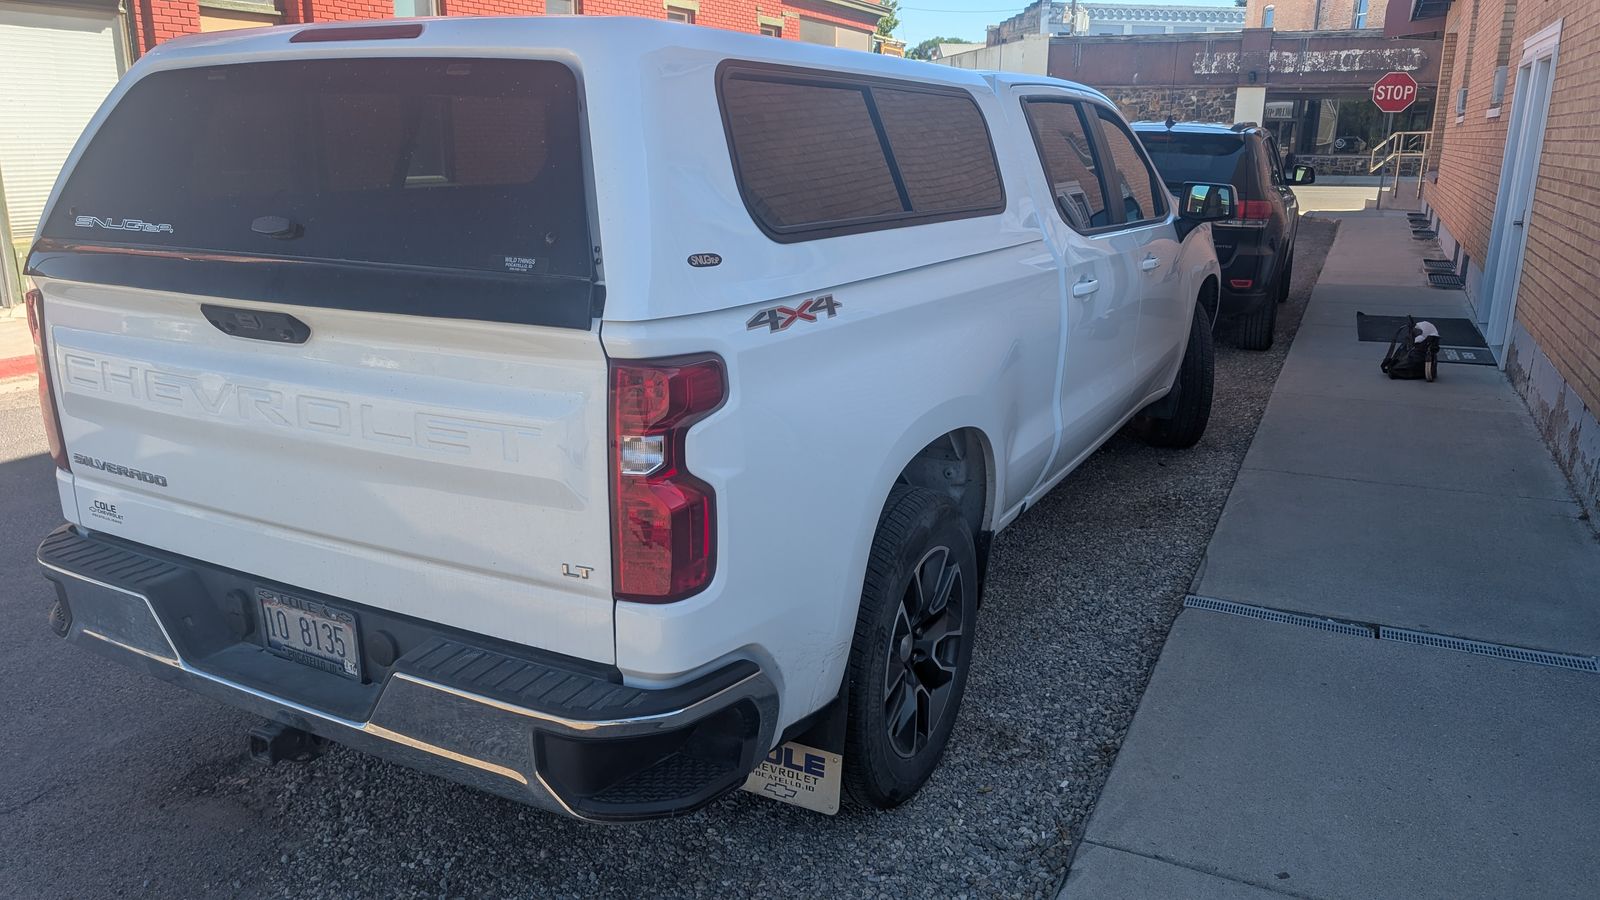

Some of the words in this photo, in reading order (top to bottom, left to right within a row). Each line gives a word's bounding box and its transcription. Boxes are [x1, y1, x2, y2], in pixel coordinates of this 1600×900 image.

[1376, 85, 1413, 100] STOP
[64, 353, 543, 462] CHEVROLET
[74, 453, 167, 487] SILVERADO
[94, 500, 117, 513] COLE
[97, 509, 124, 520] CHEVROLET
[562, 563, 594, 579] LT
[281, 595, 319, 613] COLE
[266, 607, 289, 640] 10
[299, 617, 346, 658] 8135
[766, 747, 825, 778] OLE
